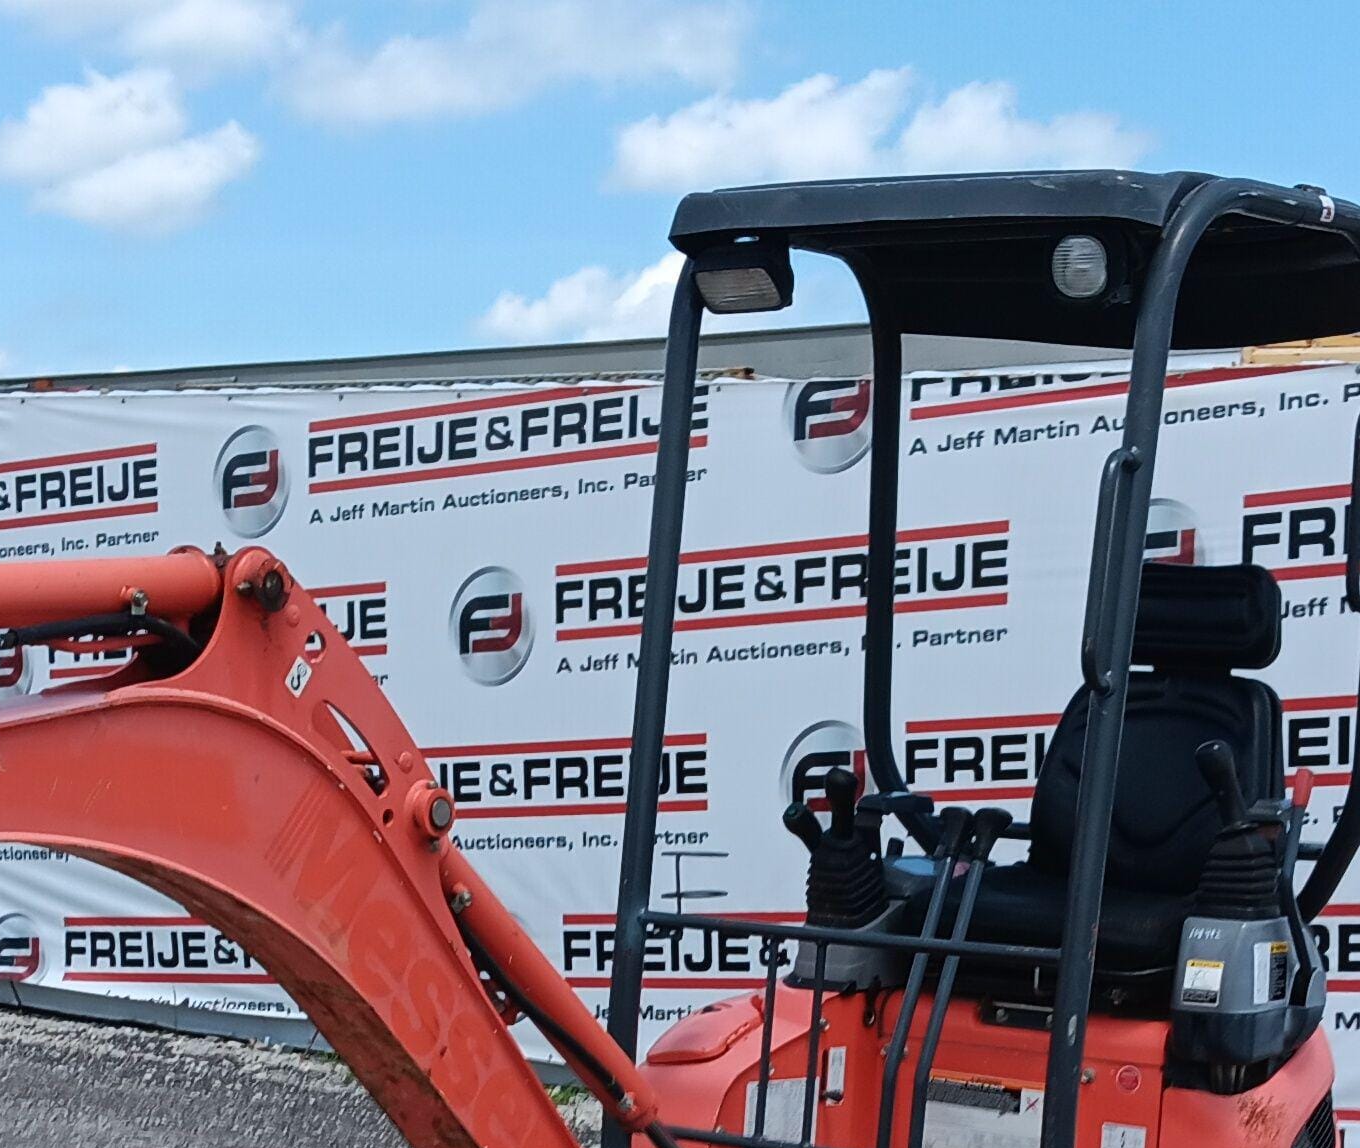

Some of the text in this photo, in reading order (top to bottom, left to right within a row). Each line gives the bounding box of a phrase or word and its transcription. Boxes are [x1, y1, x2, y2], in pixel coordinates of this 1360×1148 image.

[308, 416, 478, 478] FREIJE
[908, 437, 928, 456] A
[936, 429, 986, 453] Jeff
[993, 420, 1080, 446] Martin
[1090, 399, 1264, 434] Auoneers,
[1278, 391, 1329, 412] Inc.
[15, 458, 158, 513] FREIJE
[308, 467, 708, 525] A Jeff Martin Auctioneers, Inc. Paer
[61, 536, 90, 552] Inc.
[95, 530, 160, 549] Partner
[555, 559, 745, 624] FREJE
[555, 656, 573, 675] A
[579, 652, 620, 673] Jeff
[627, 646, 698, 668] Mtin
[705, 640, 850, 664] Auctioneers,
[911, 627, 1009, 648] Partner
[524, 750, 707, 800] FREJE
[906, 732, 1045, 784] FREI
[452, 830, 709, 850] Auctioneers, Inc. rtner
[64, 930, 209, 969] FREIJE
[640, 1005, 693, 1020] Marti
